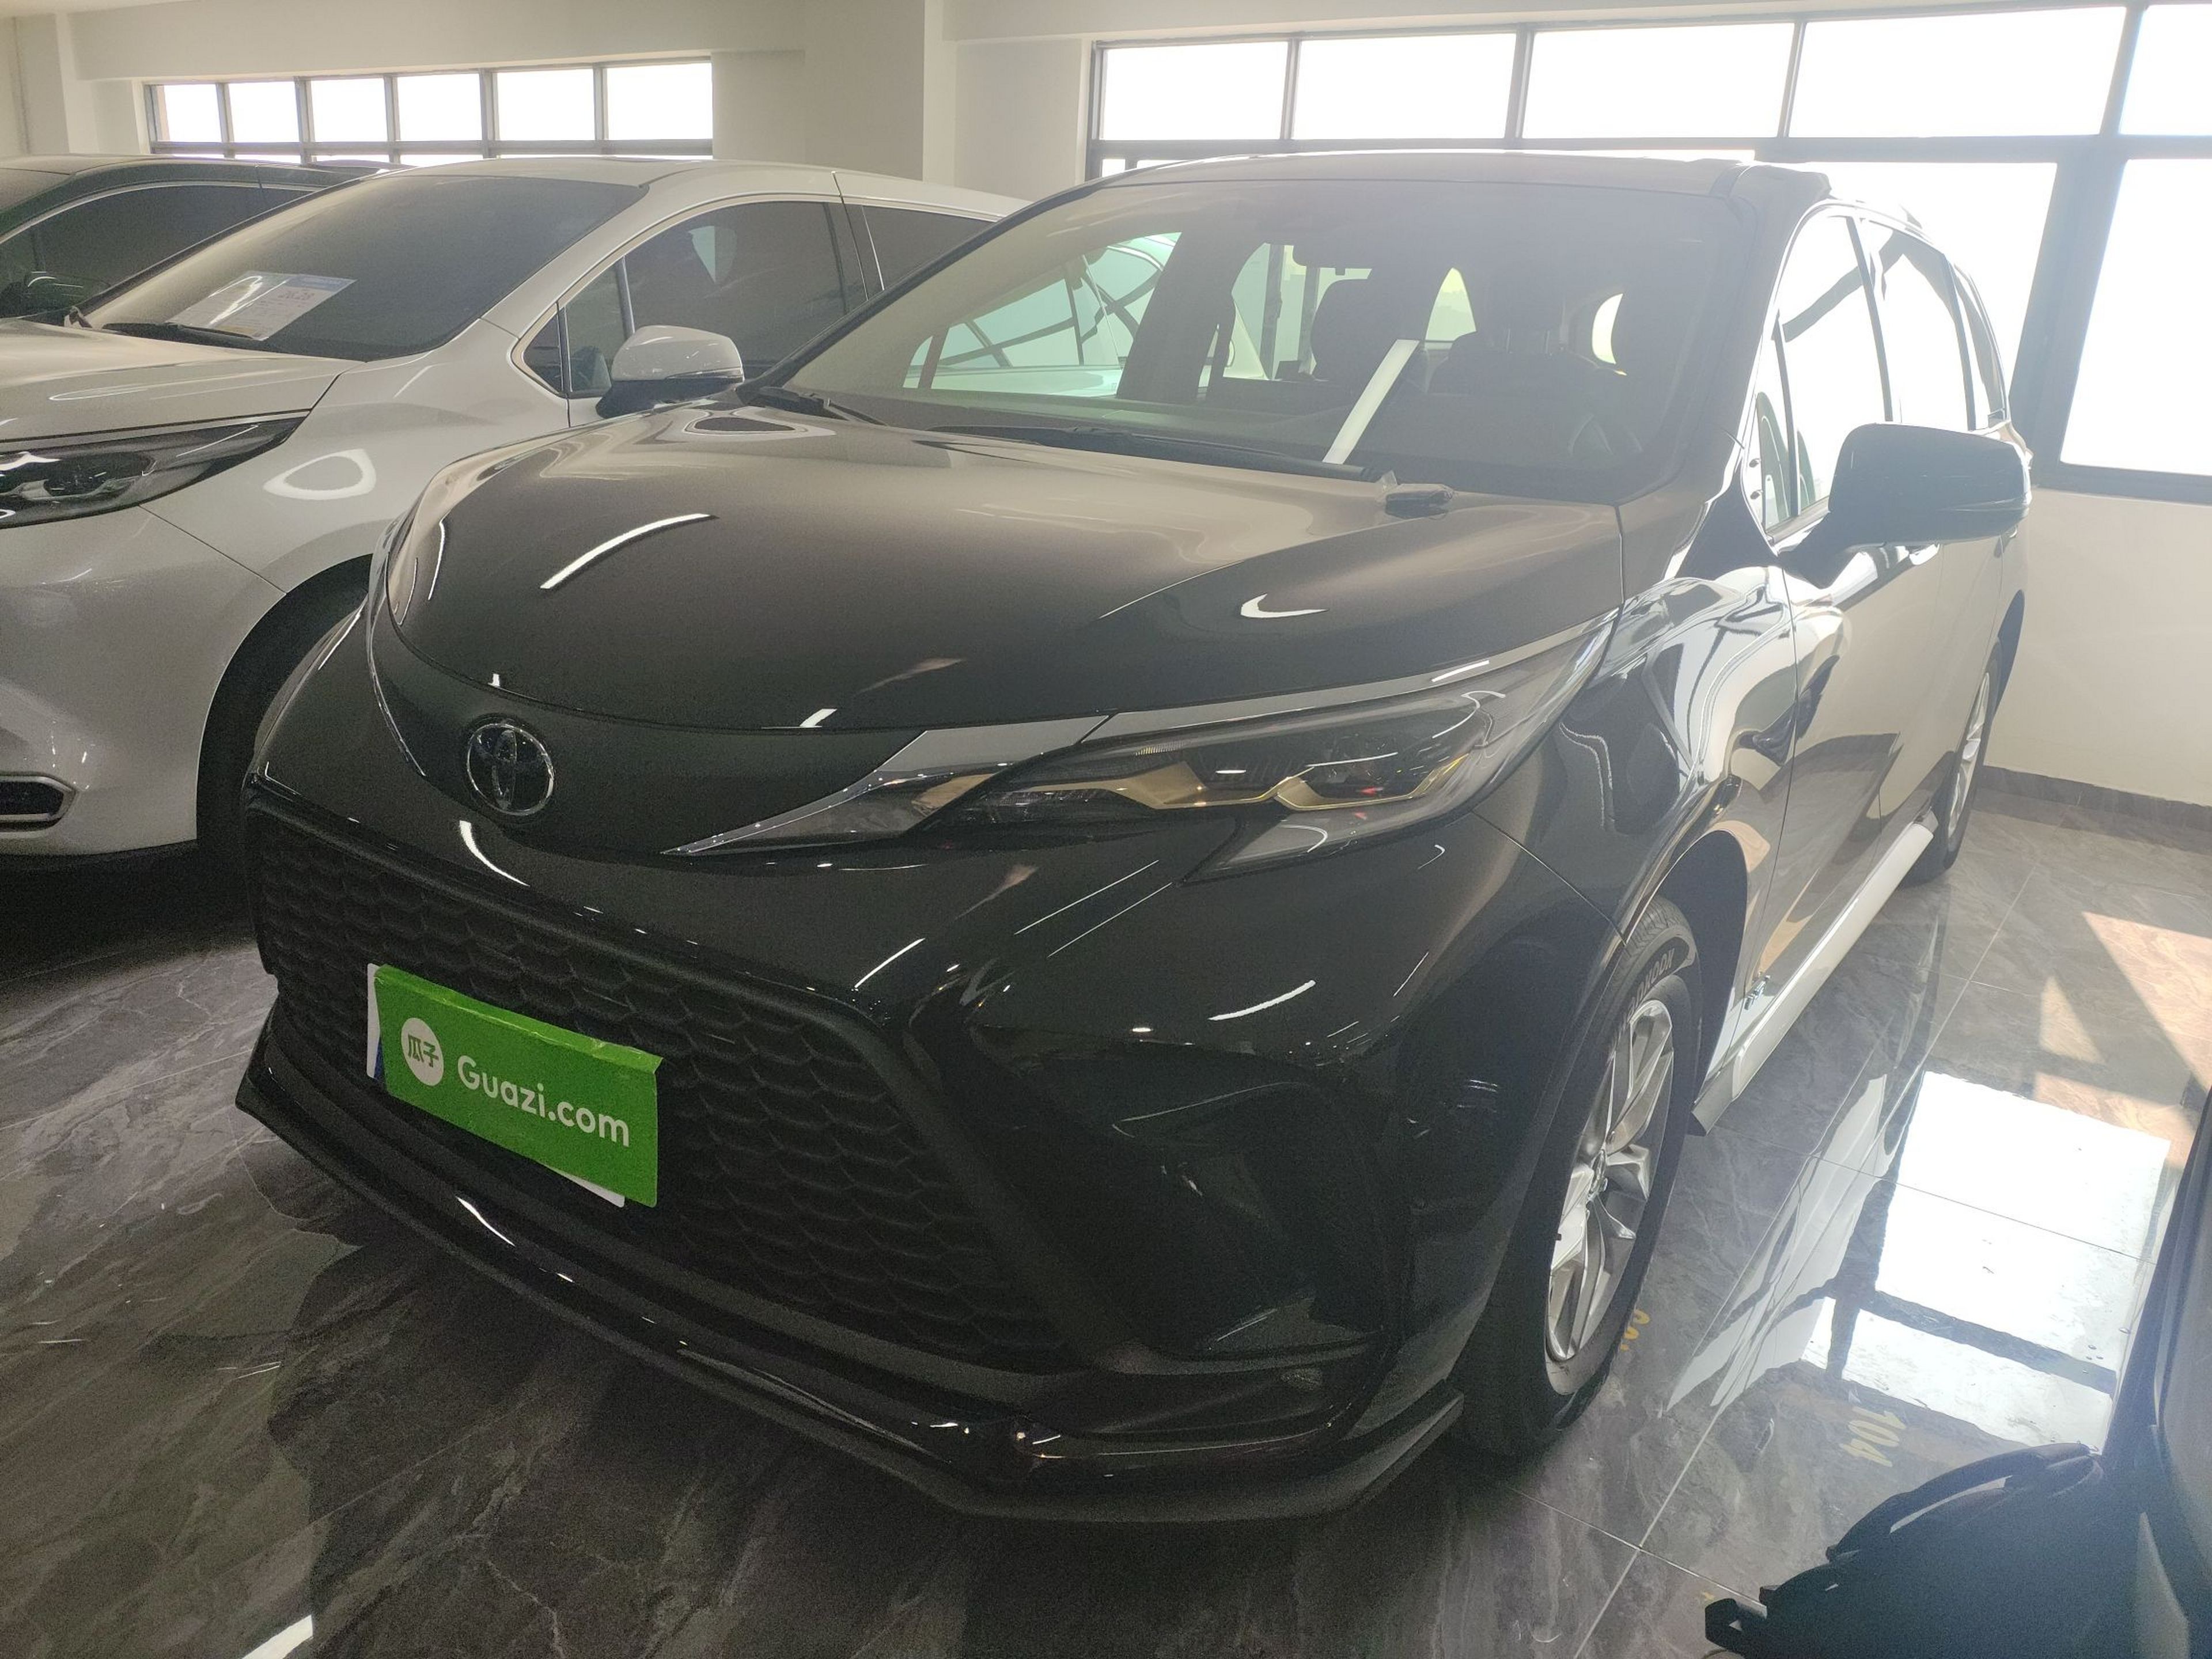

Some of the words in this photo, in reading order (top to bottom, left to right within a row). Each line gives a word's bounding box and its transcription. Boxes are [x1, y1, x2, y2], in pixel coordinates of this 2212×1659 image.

[407, 1034, 440, 1067] 瓜子
[458, 1055, 629, 1147] Guazi.com
[1839, 1406, 1907, 1467] 104
